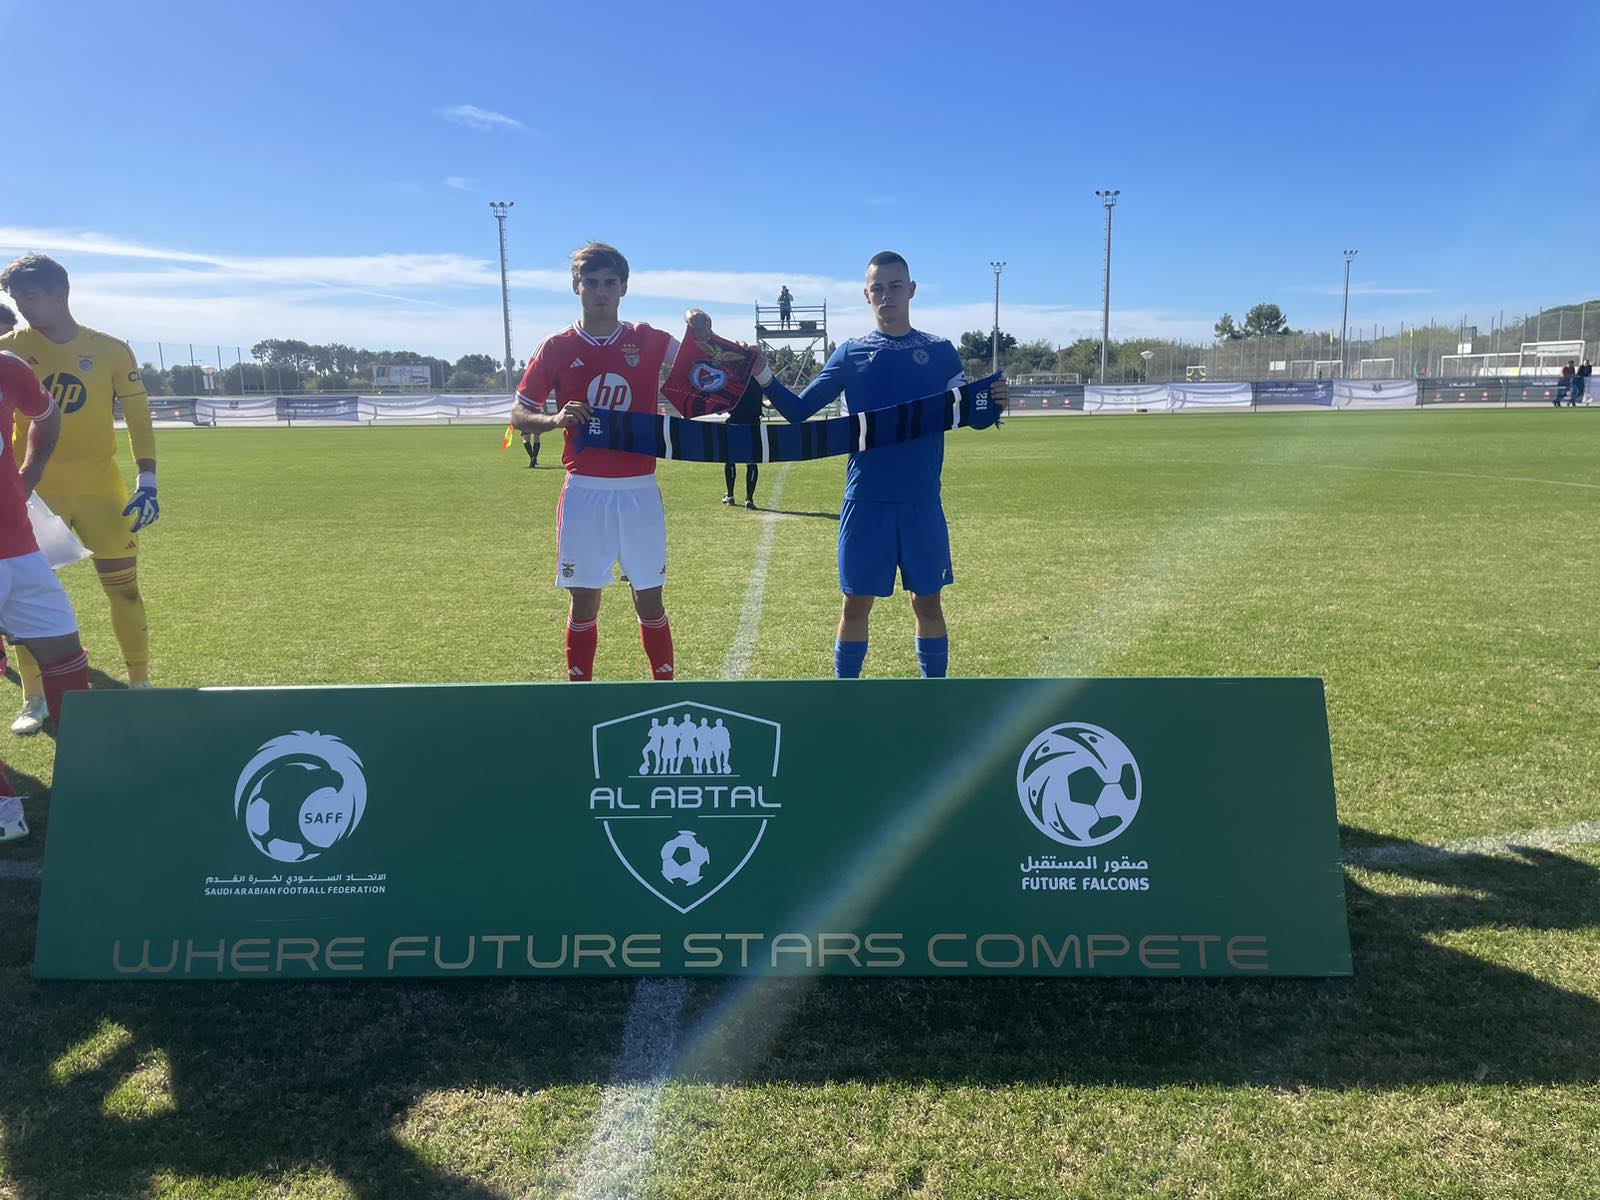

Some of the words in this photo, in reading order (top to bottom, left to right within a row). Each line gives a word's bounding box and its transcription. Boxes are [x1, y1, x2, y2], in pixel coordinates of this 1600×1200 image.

[49, 372, 82, 415] hp
[593, 372, 628, 411] hp
[976, 389, 989, 411] 192
[589, 787, 640, 810] AL
[651, 786, 782, 809] ABTAL
[304, 812, 343, 824] SAFF
[1020, 855, 1097, 874] المستقبل
[1103, 855, 1149, 873] صقور
[204, 887, 233, 896] SAUDI
[233, 886, 276, 895] ARABIAN
[277, 886, 326, 895] FOOTBALL
[327, 885, 386, 894] FEDERATION
[1021, 877, 1077, 890] FUTURE
[1082, 877, 1150, 891] FALCONS
[112, 937, 365, 973] WHERE
[387, 934, 661, 970] FUTURE
[683, 933, 905, 968] STARS
[927, 933, 1269, 970] COMPETE
